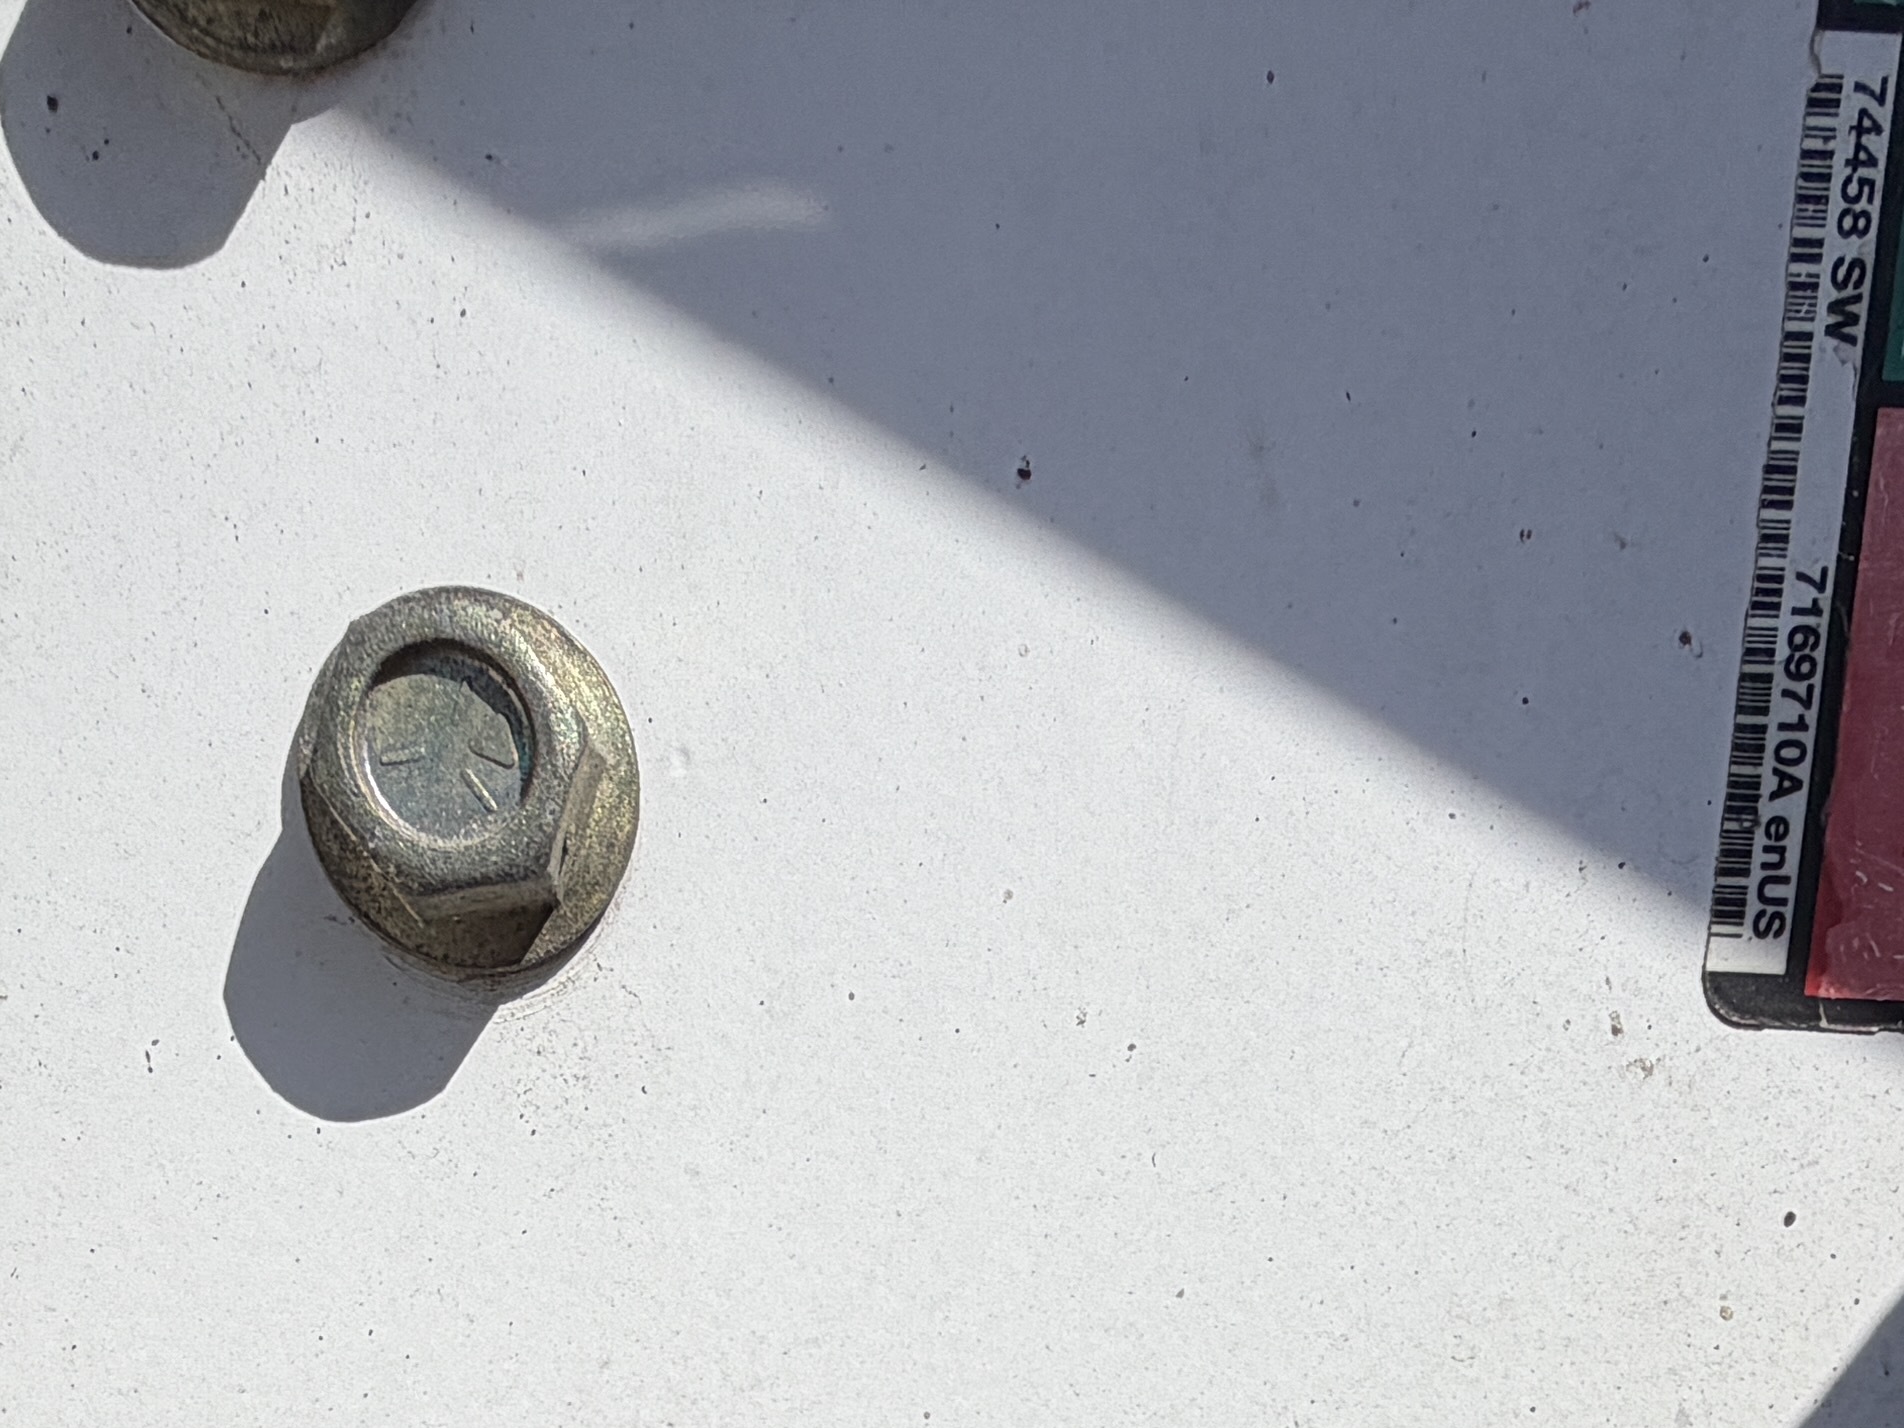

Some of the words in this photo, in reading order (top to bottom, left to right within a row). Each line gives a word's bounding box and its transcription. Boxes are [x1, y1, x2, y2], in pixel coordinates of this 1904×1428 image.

[1836, 75, 1889, 239] 74458
[1824, 255, 1868, 347] SW
[1768, 565, 1829, 803] 7169710A
[1752, 815, 1792, 941] enUS
